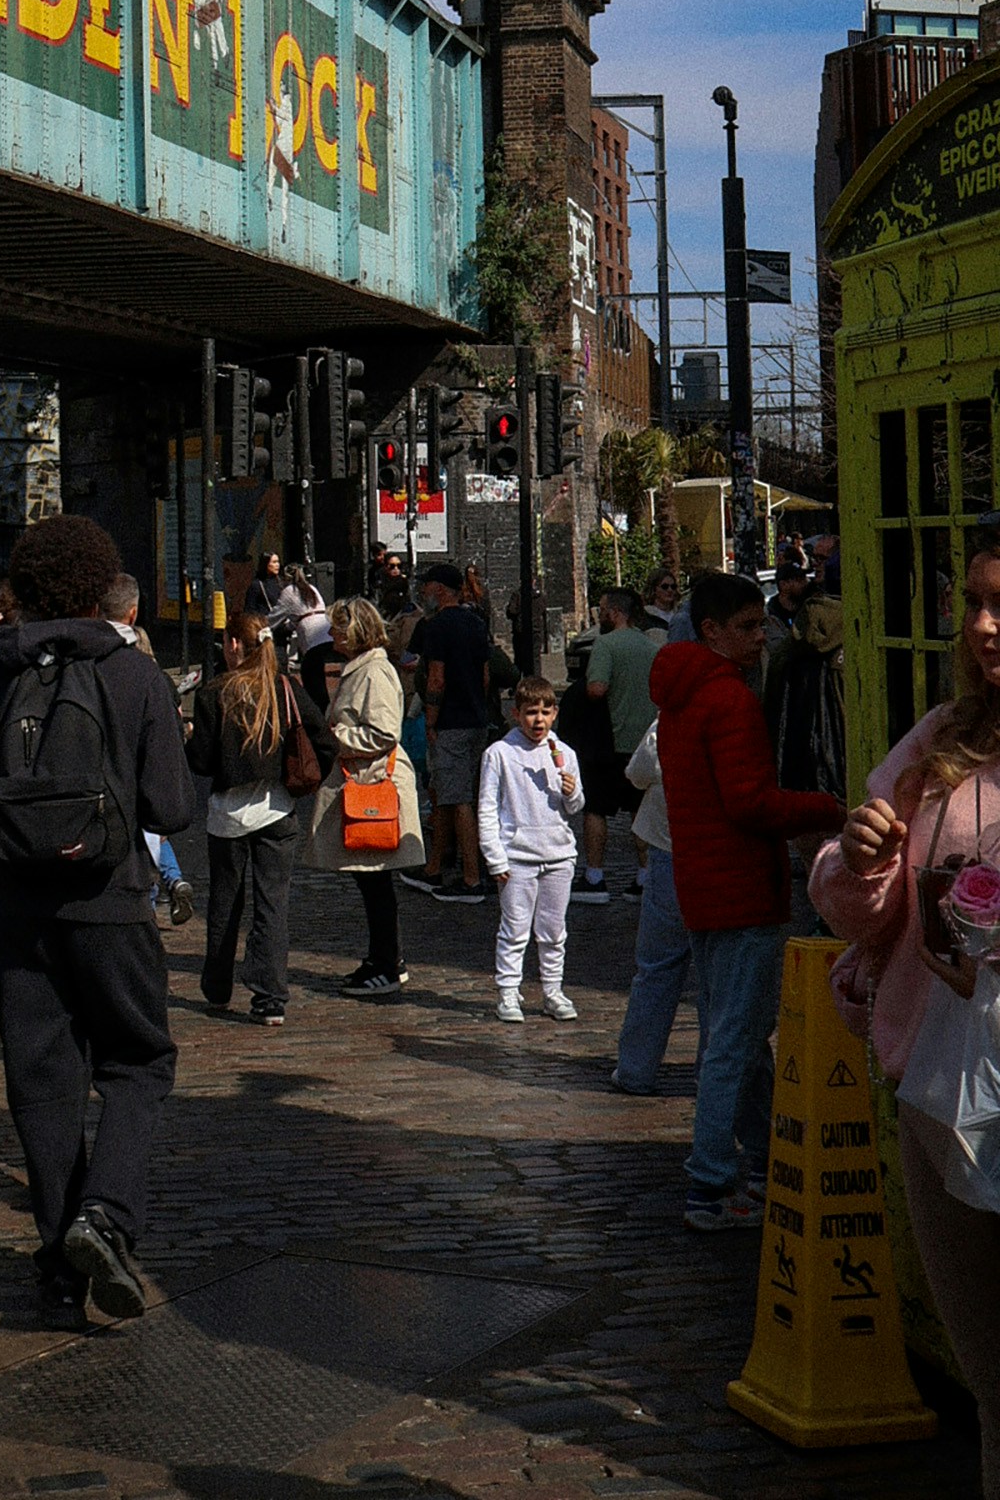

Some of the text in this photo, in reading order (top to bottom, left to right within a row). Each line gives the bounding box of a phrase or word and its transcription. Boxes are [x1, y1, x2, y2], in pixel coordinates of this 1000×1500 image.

[940, 139, 980, 176] EPIC
[776, 1113, 802, 1145] CAUTION
[821, 1121, 870, 1148] CAUTION
[773, 1159, 803, 1194] CUIDADO
[821, 1169, 876, 1195] CUIDADO
[769, 1200, 804, 1238] ATTENTION
[821, 1213, 884, 1238] ATTENTION
